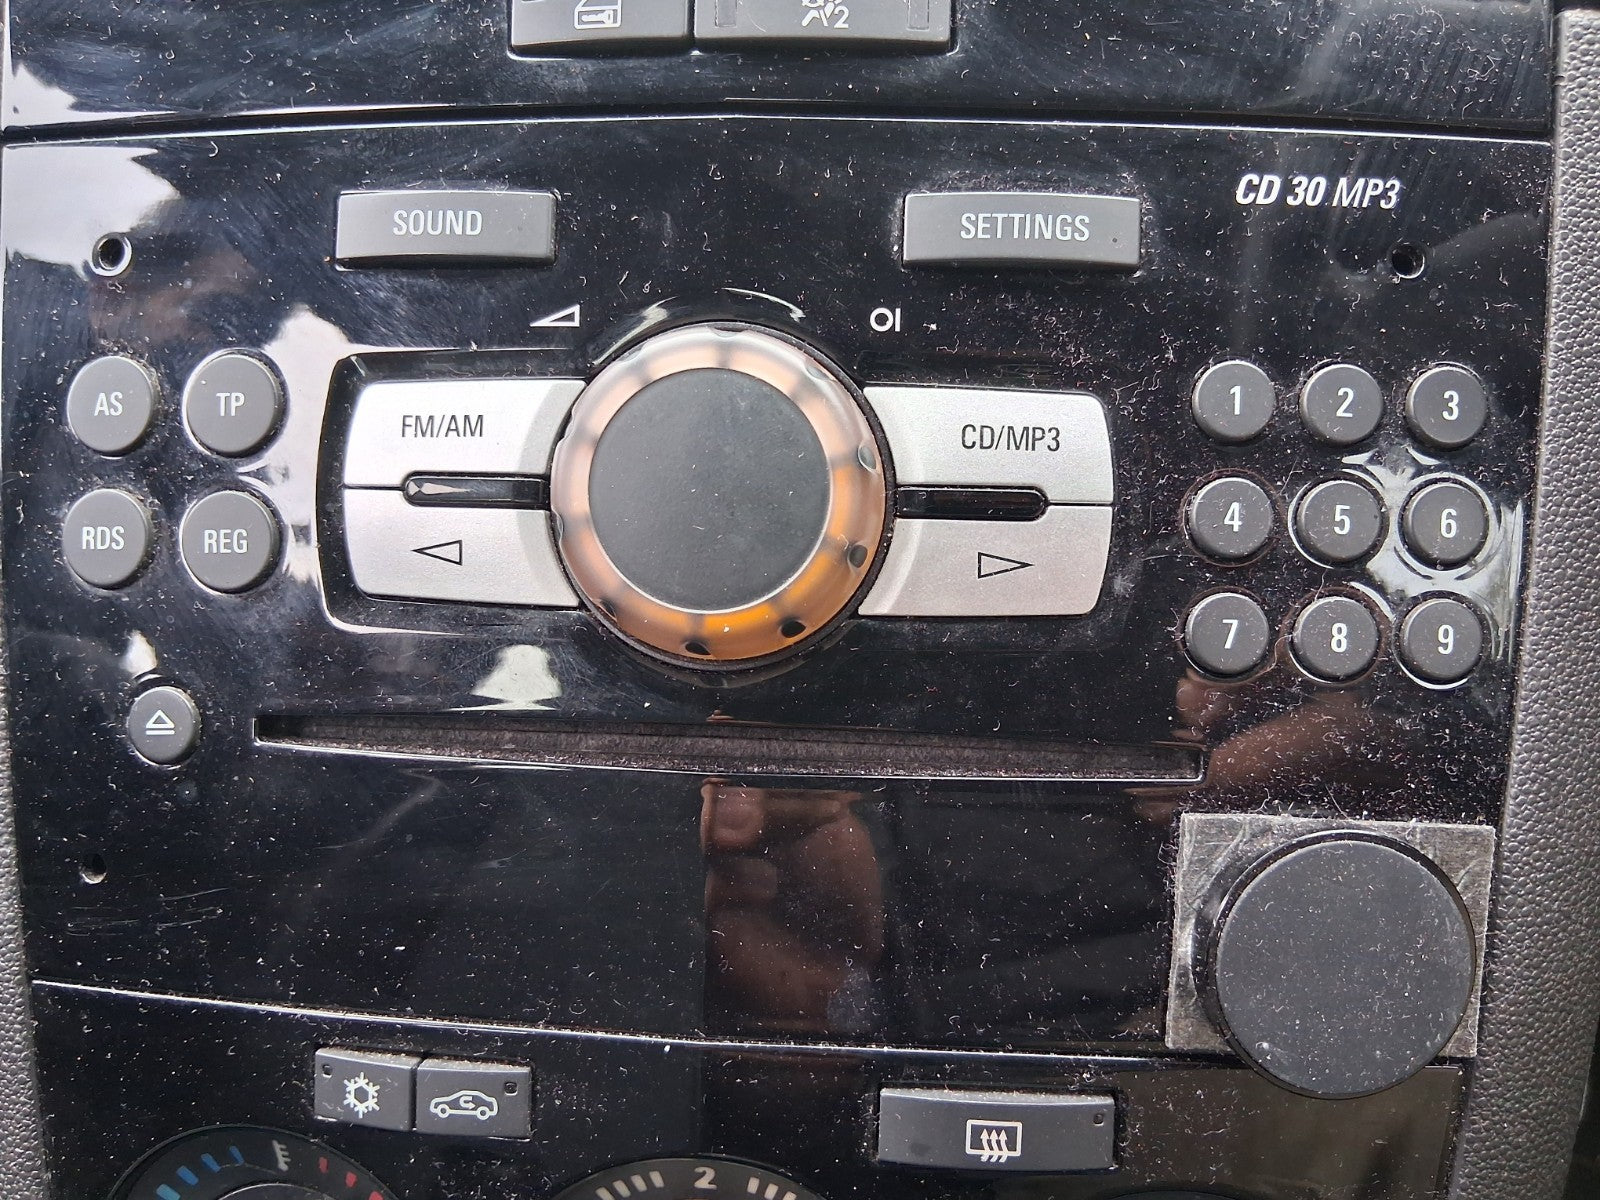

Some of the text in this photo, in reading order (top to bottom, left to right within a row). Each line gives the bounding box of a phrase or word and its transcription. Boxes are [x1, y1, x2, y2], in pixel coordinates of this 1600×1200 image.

[833, 5, 850, 29] 2
[1235, 173, 1401, 209] CD 30 MP3
[392, 209, 483, 236] SOUND
[960, 212, 1090, 242] SETTINGS
[93, 391, 123, 417] AS
[215, 392, 245, 417] TP
[1229, 385, 1241, 416] 1
[1335, 387, 1355, 418] 2
[1442, 390, 1460, 421] 3
[401, 414, 484, 438] FM/AM
[961, 423, 1061, 452] CD/MP3
[1223, 501, 1243, 532] 4
[1333, 504, 1351, 535] 5
[1440, 508, 1457, 539] 6
[81, 525, 125, 550] RDS
[203, 528, 248, 554] REG
[1222, 619, 1239, 649] 7
[1330, 622, 1348, 653] 8
[1437, 624, 1454, 655] 9
[694, 1166, 717, 1189] 2
